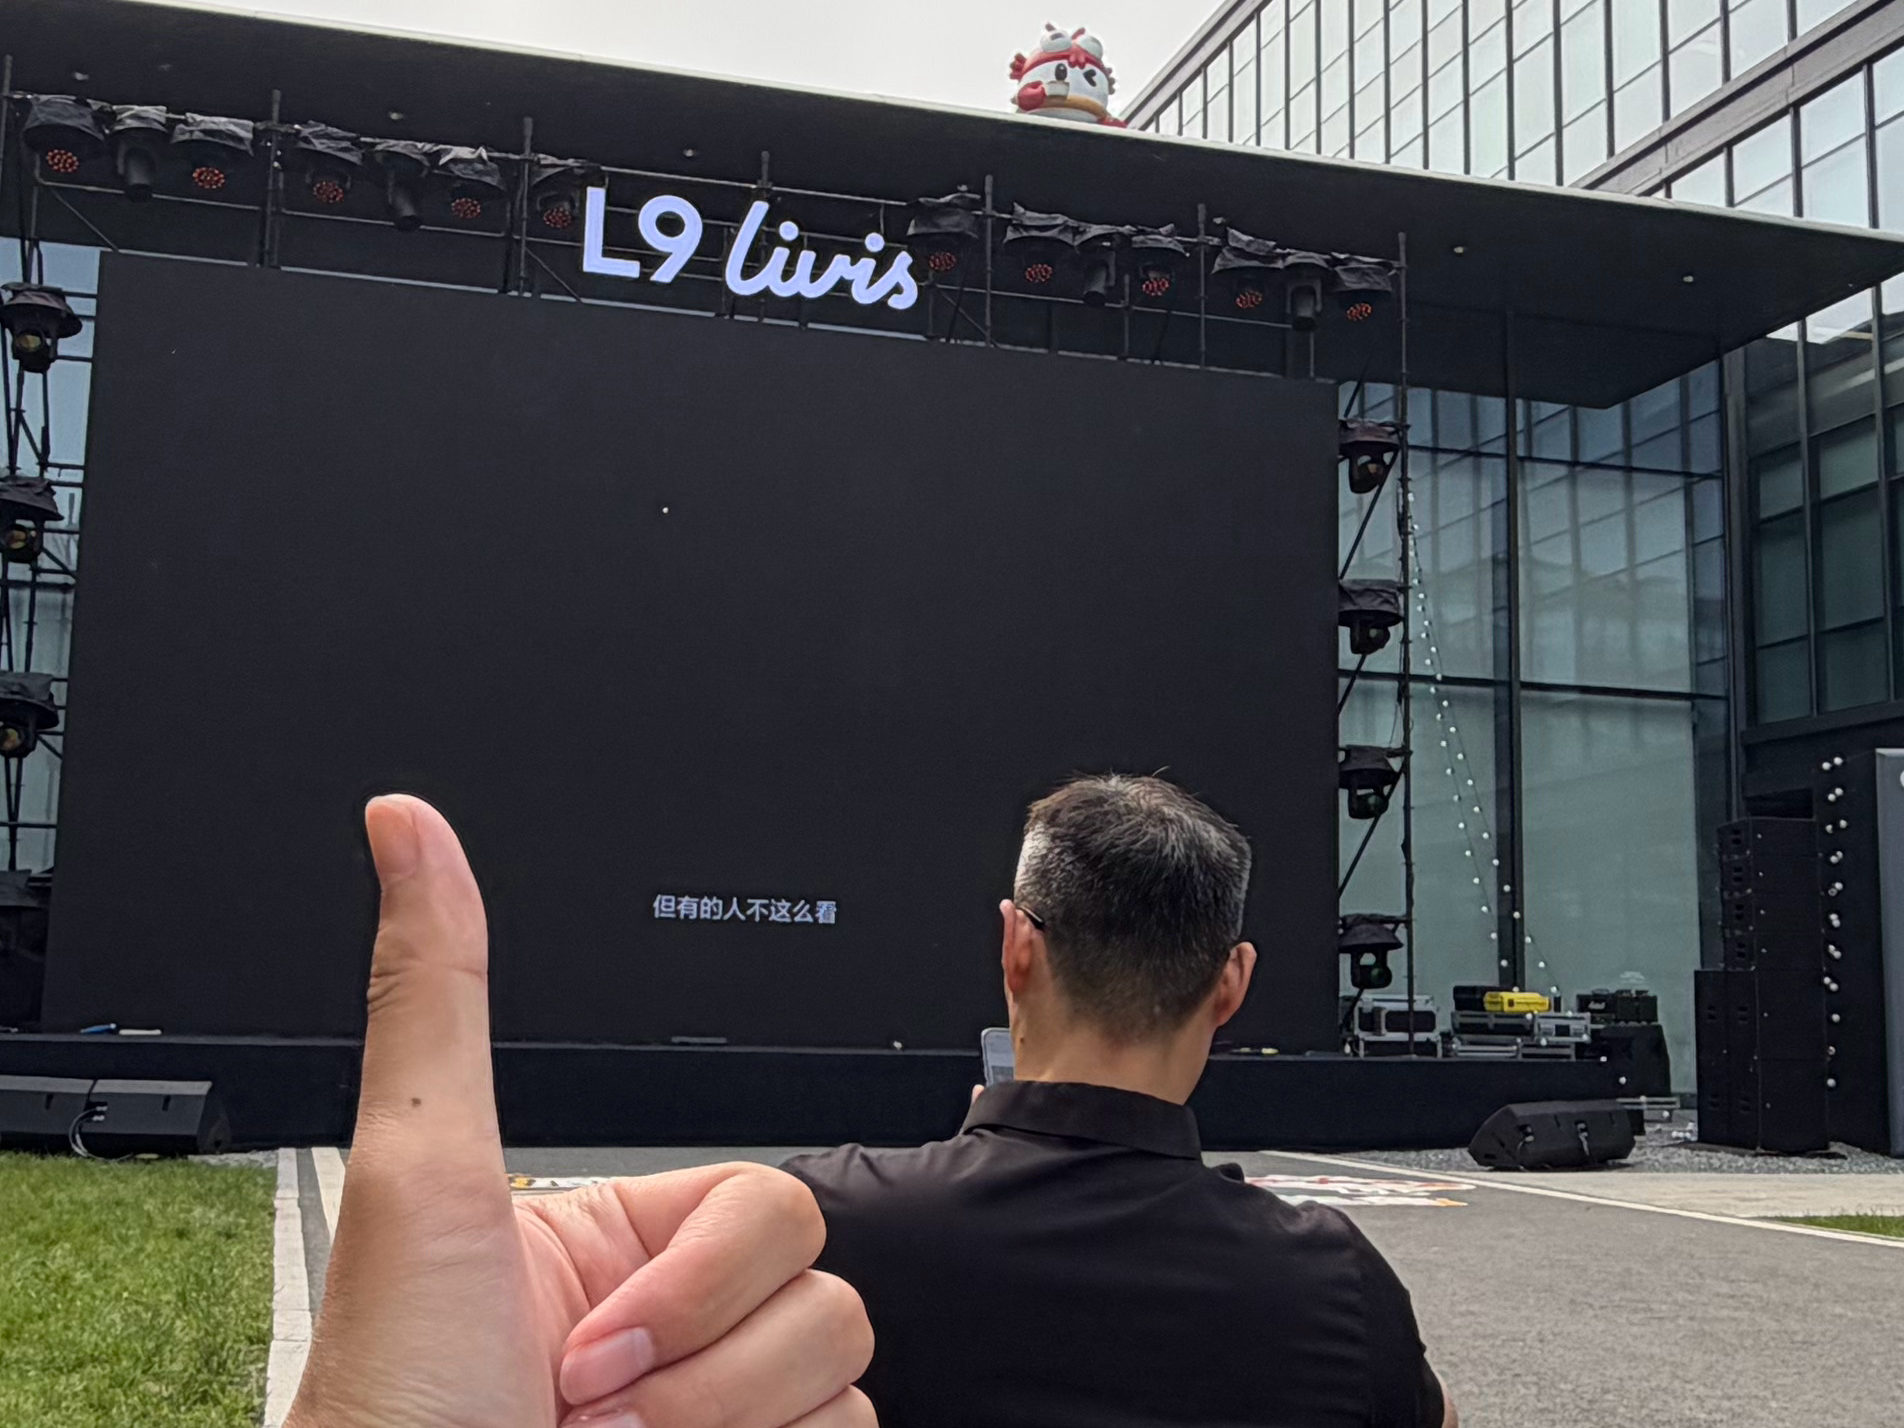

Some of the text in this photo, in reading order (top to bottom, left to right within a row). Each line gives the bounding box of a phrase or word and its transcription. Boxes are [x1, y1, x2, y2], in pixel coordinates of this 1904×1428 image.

[582, 186, 919, 311] L9 livis
[652, 893, 837, 924] 但有的人不这么看
